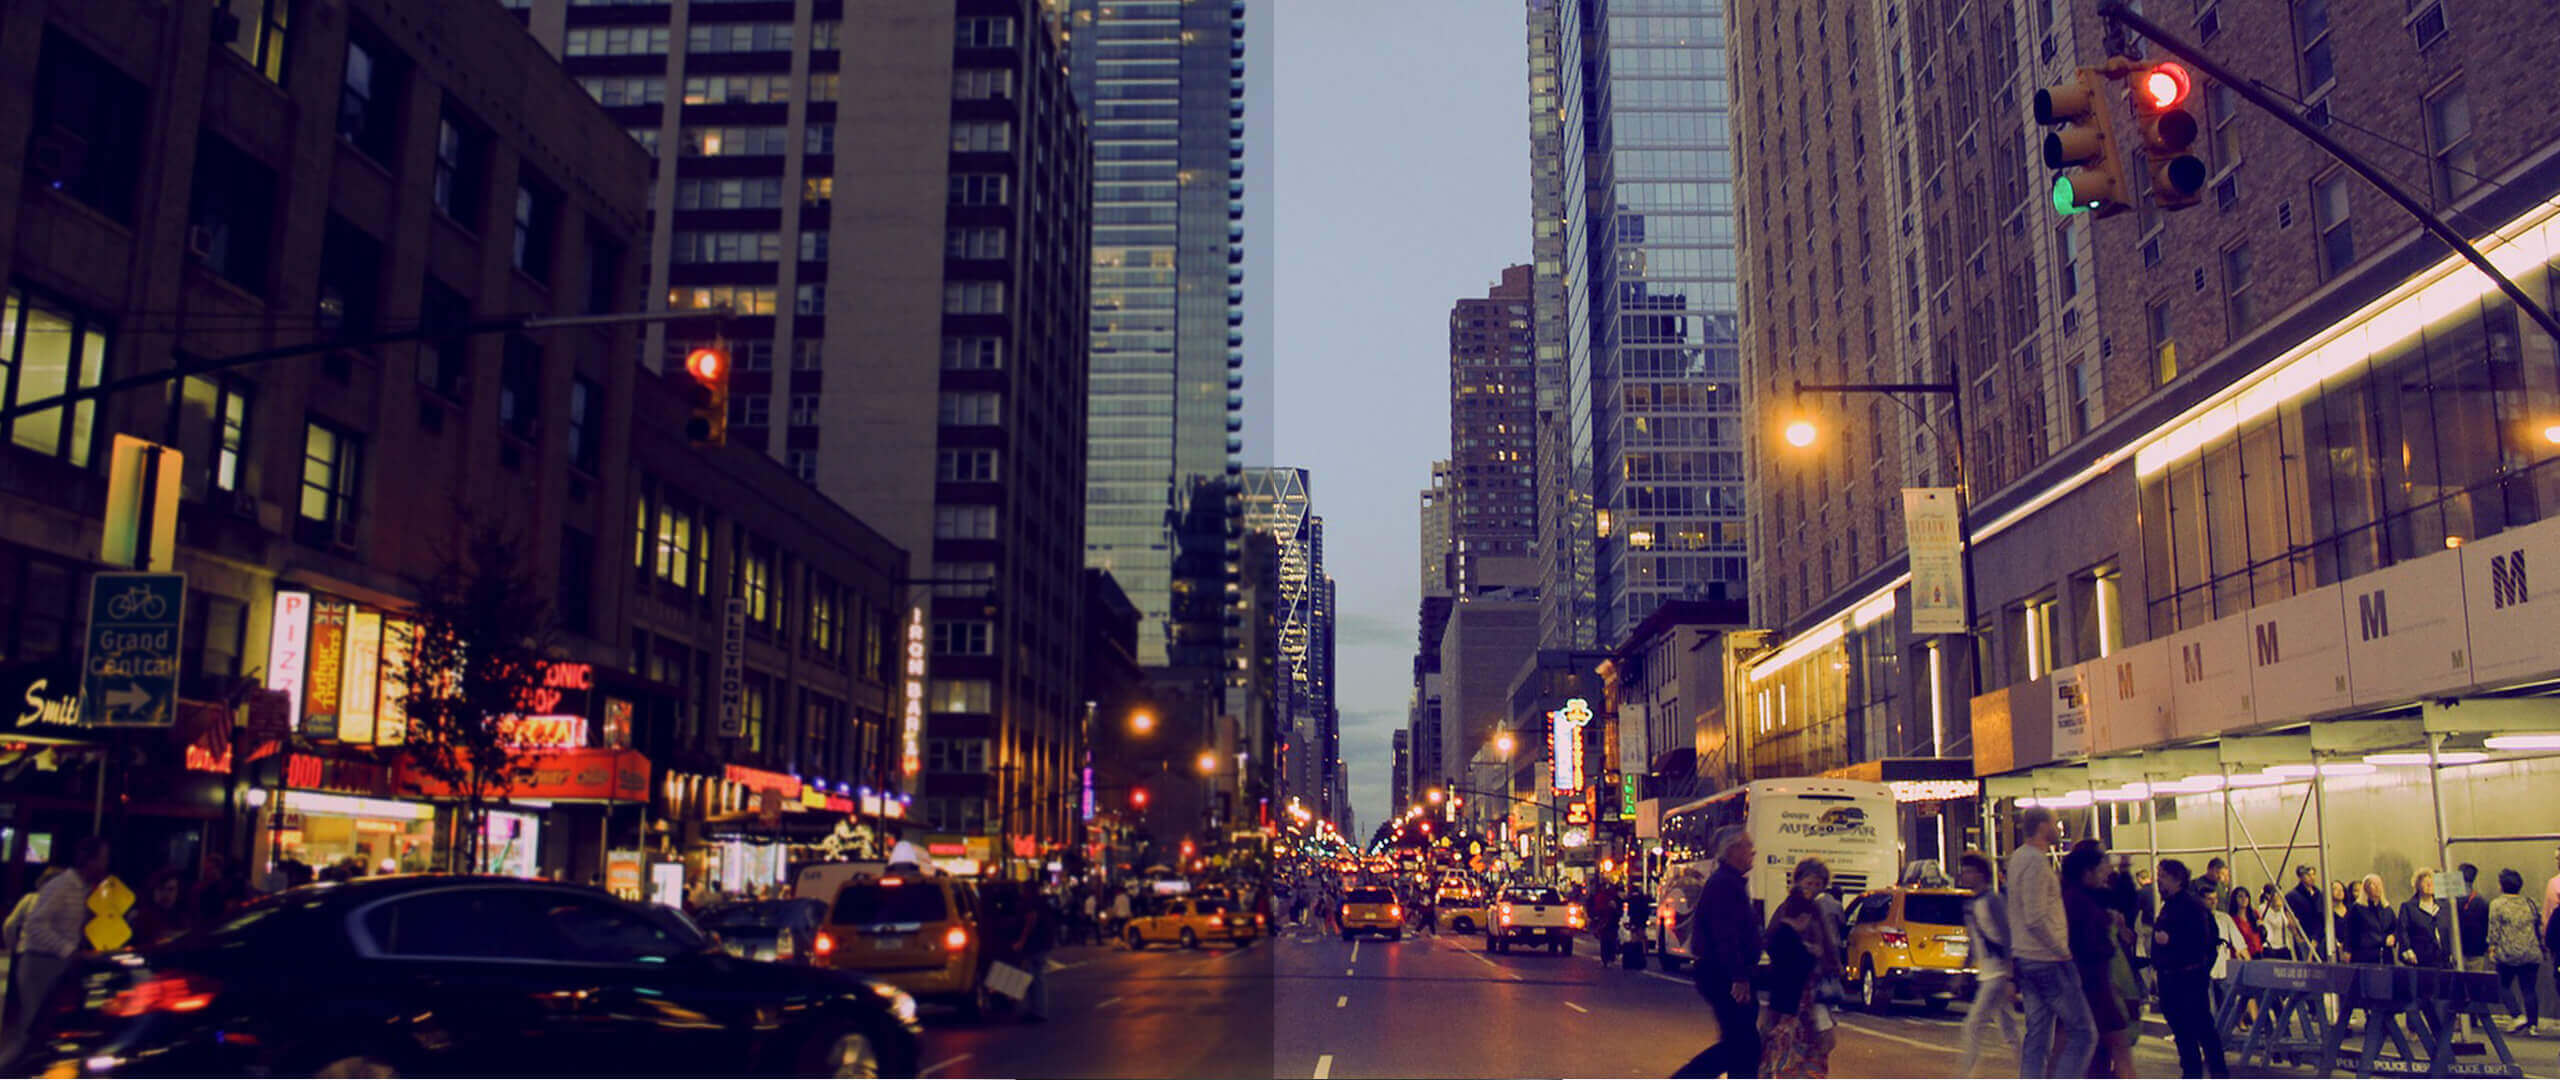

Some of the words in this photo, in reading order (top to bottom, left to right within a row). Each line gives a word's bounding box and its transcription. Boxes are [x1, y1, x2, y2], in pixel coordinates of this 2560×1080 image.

[2491, 548, 2529, 610] M
[2359, 590, 2389, 643] M
[99, 629, 169, 651] Grand
[906, 606, 927, 677] IRON
[2255, 620, 2280, 667] M
[2451, 649, 2465, 669] M
[89, 654, 176, 679] Central
[721, 603, 741, 732] ELECTRONIC
[2117, 661, 2136, 701] M
[2183, 642, 2204, 685] M
[268, 813, 300, 825] AM
[2373, 1059, 2409, 1073] POLICE
